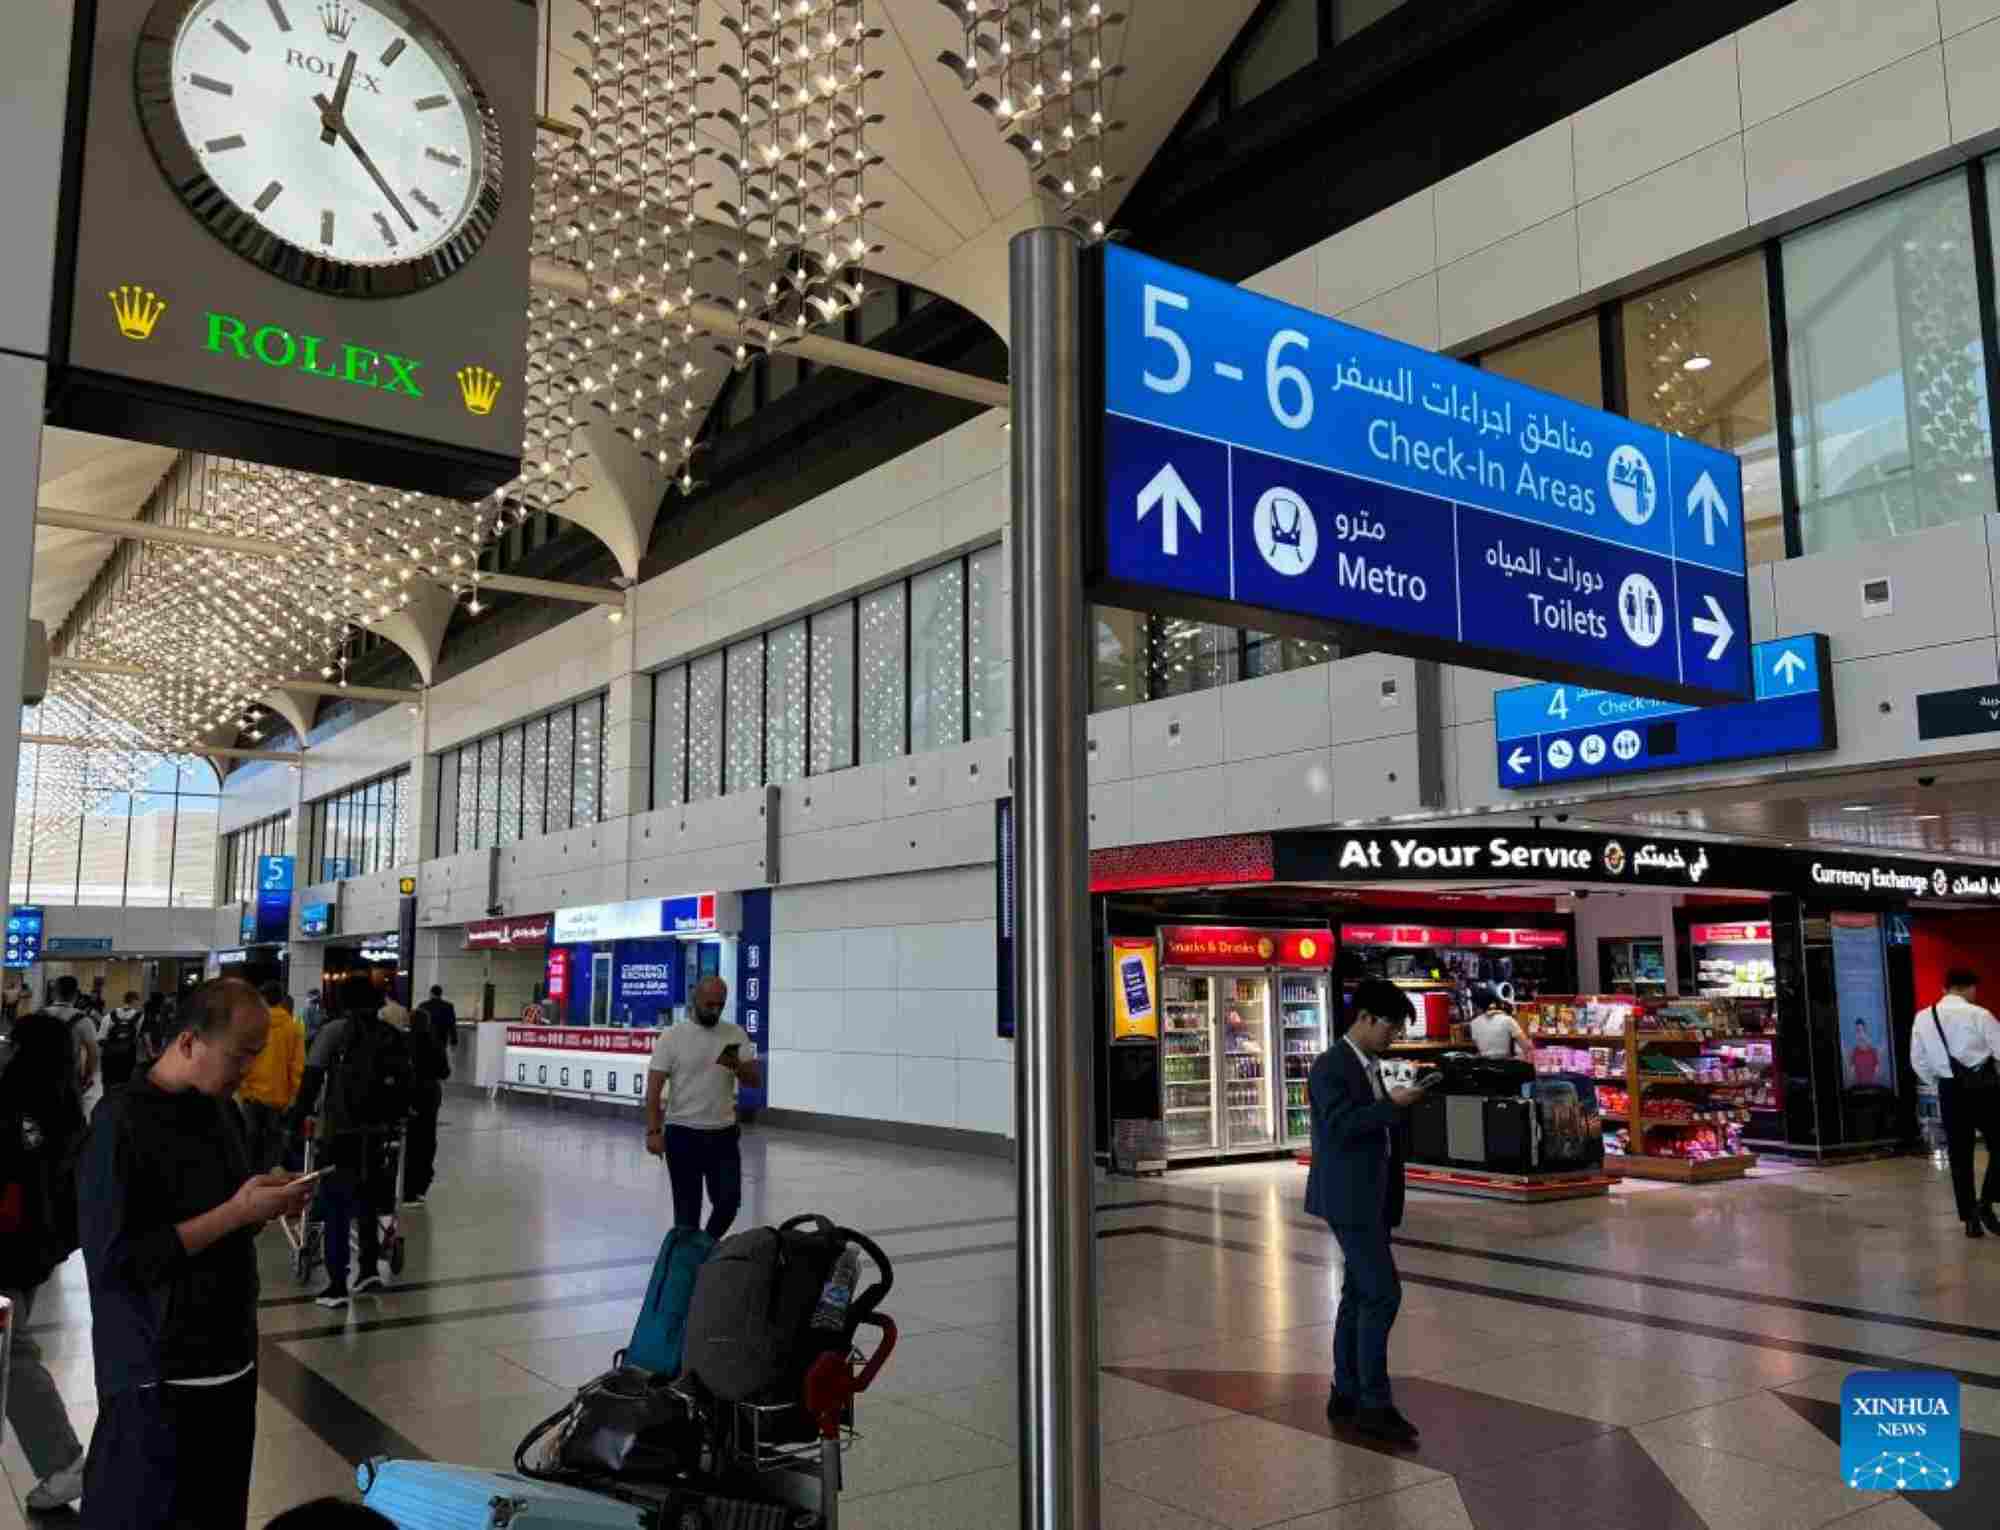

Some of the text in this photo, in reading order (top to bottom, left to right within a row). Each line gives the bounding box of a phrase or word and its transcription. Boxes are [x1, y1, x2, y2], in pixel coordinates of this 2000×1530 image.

[286, 48, 382, 94] ROLX
[204, 312, 424, 399] ROLEX
[1331, 355, 1414, 405] السفر
[1520, 413, 1593, 459] مناطق
[1368, 419, 1596, 516] Check-In Areas
[1335, 510, 1386, 541] مترو
[1338, 552, 1427, 602] Metro
[1486, 540, 1604, 594] دورات المياه
[1527, 593, 1608, 639] Toilets
[1547, 688, 1568, 720] 4
[268, 857, 284, 880] 5
[1339, 838, 1592, 869] At Your Service
[1811, 863, 1928, 897] Currency Exchange
